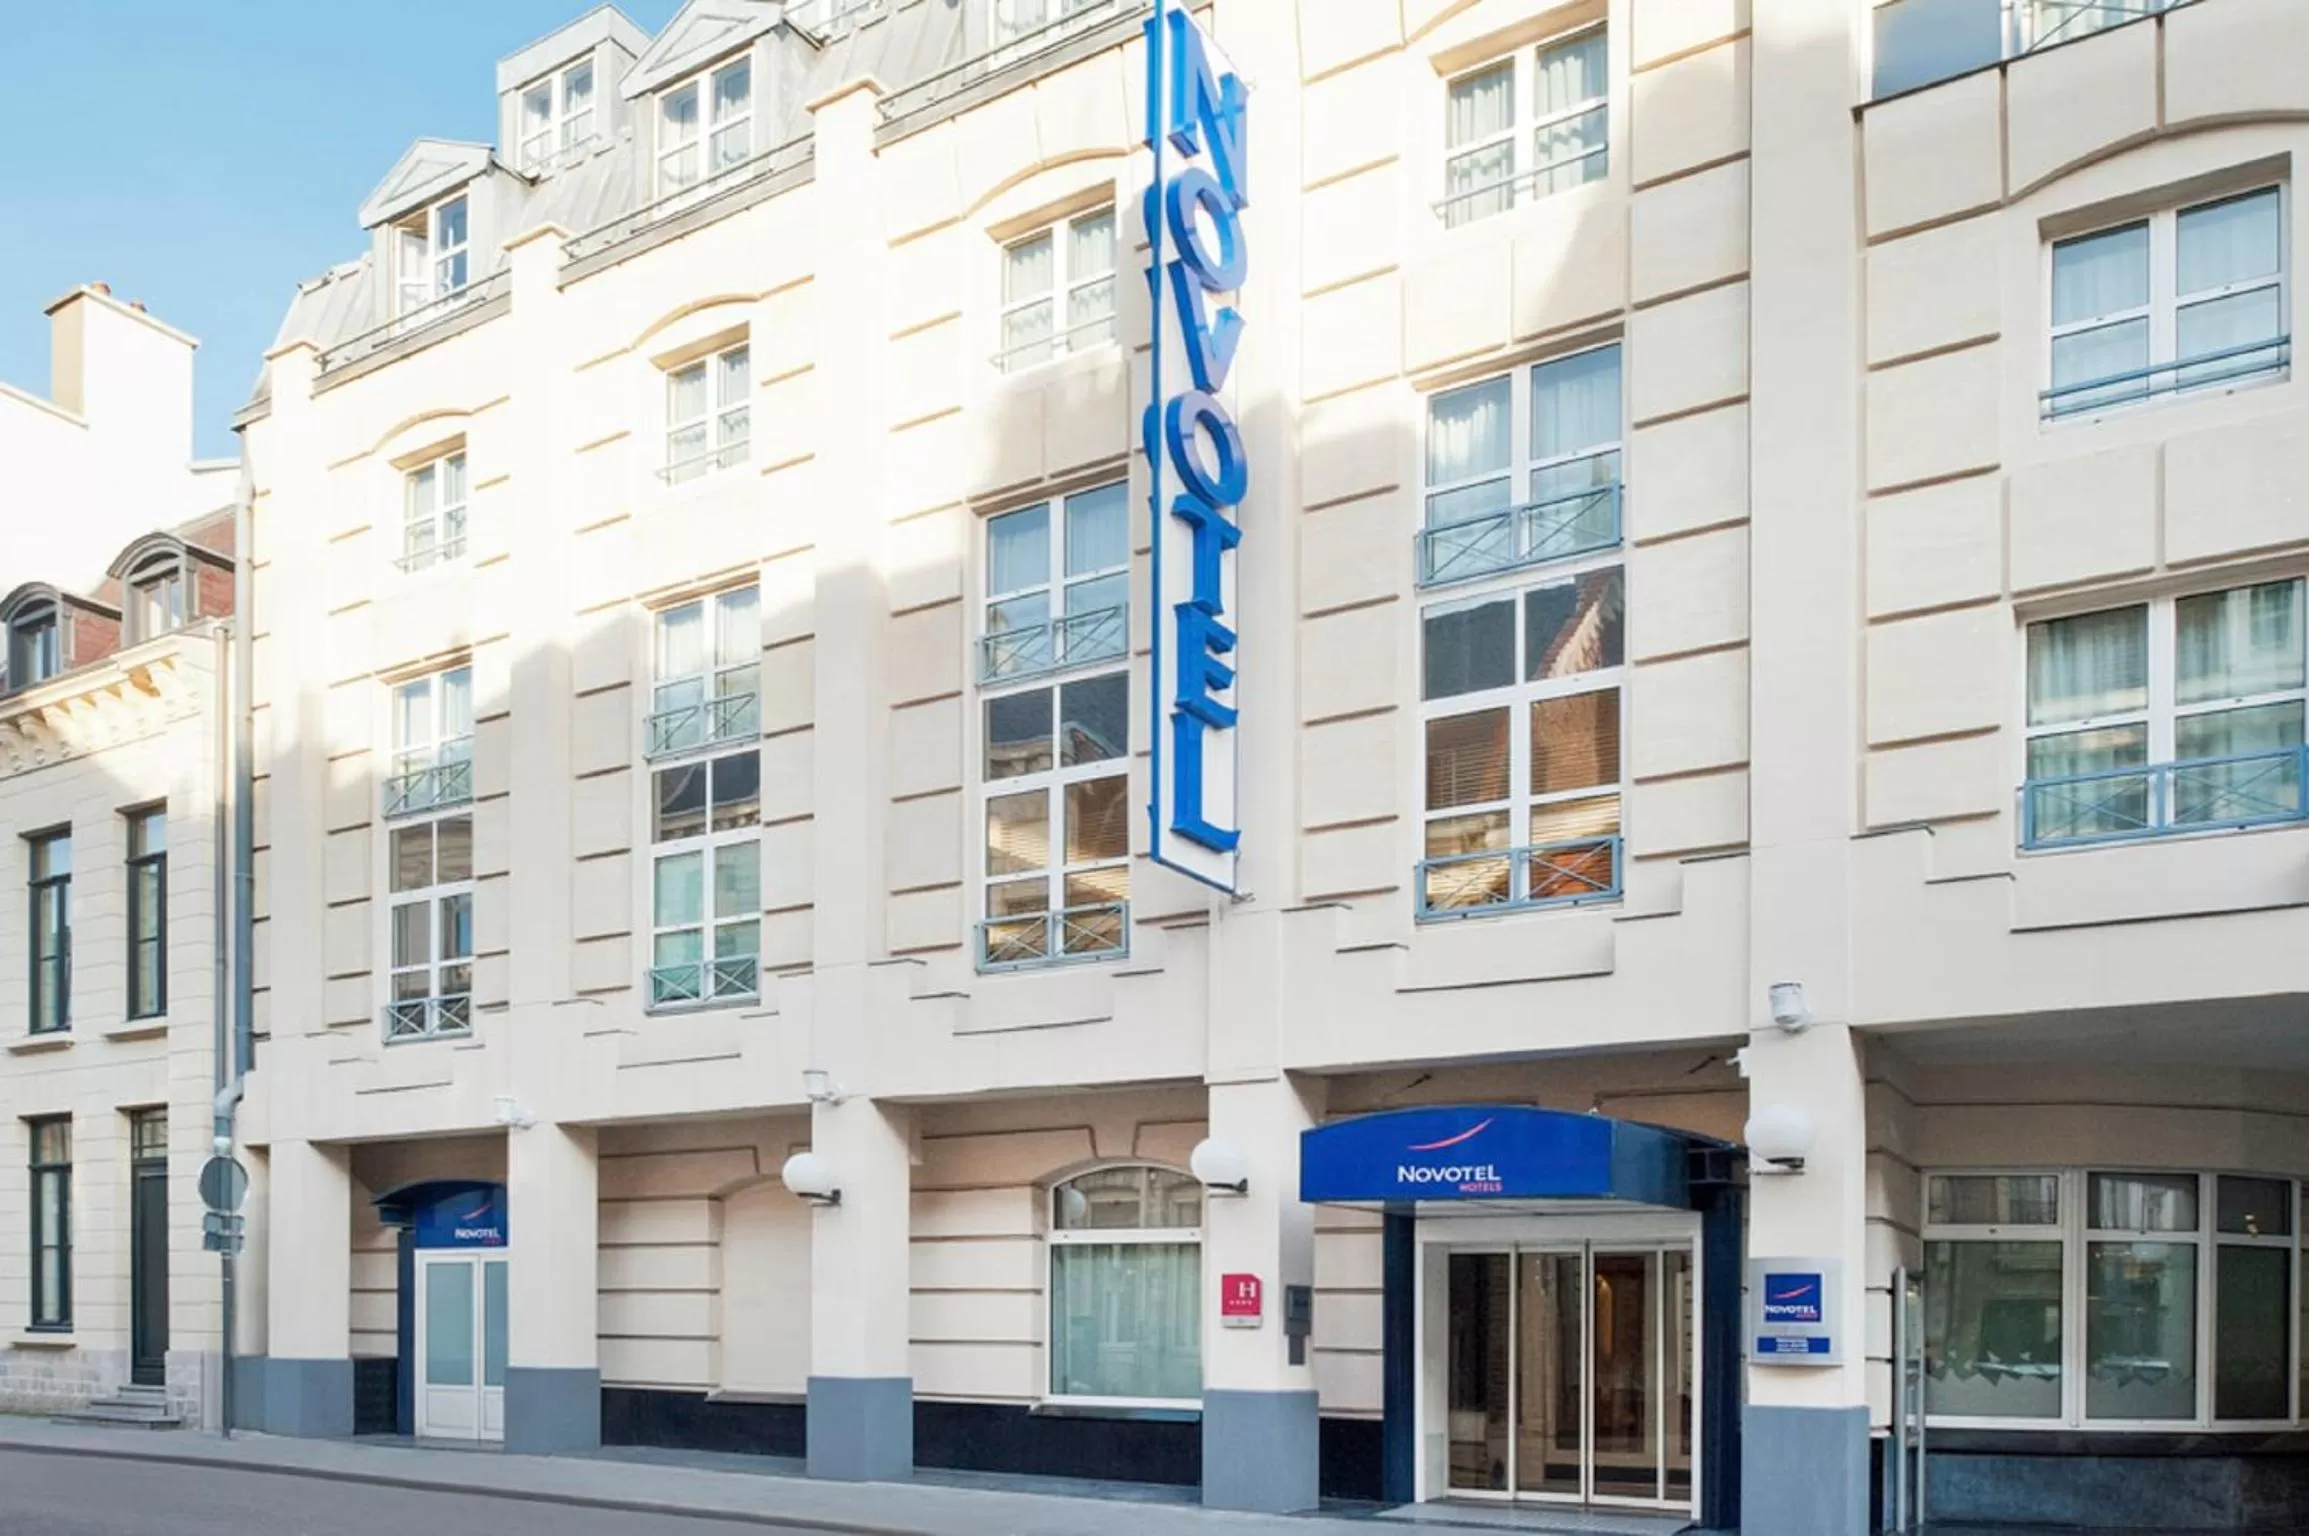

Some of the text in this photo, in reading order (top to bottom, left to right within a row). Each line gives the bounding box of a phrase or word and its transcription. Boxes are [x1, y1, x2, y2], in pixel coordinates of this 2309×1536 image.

[1165, 8, 1249, 854] NOVOTEL
[1397, 1164, 1502, 1183] NOVOTEL
[1459, 1181, 1503, 1193] HOTELS
[454, 1226, 501, 1240] NOVOTEL
[1238, 1281, 1257, 1298] H
[1765, 1304, 1817, 1314] NOVOTEL
